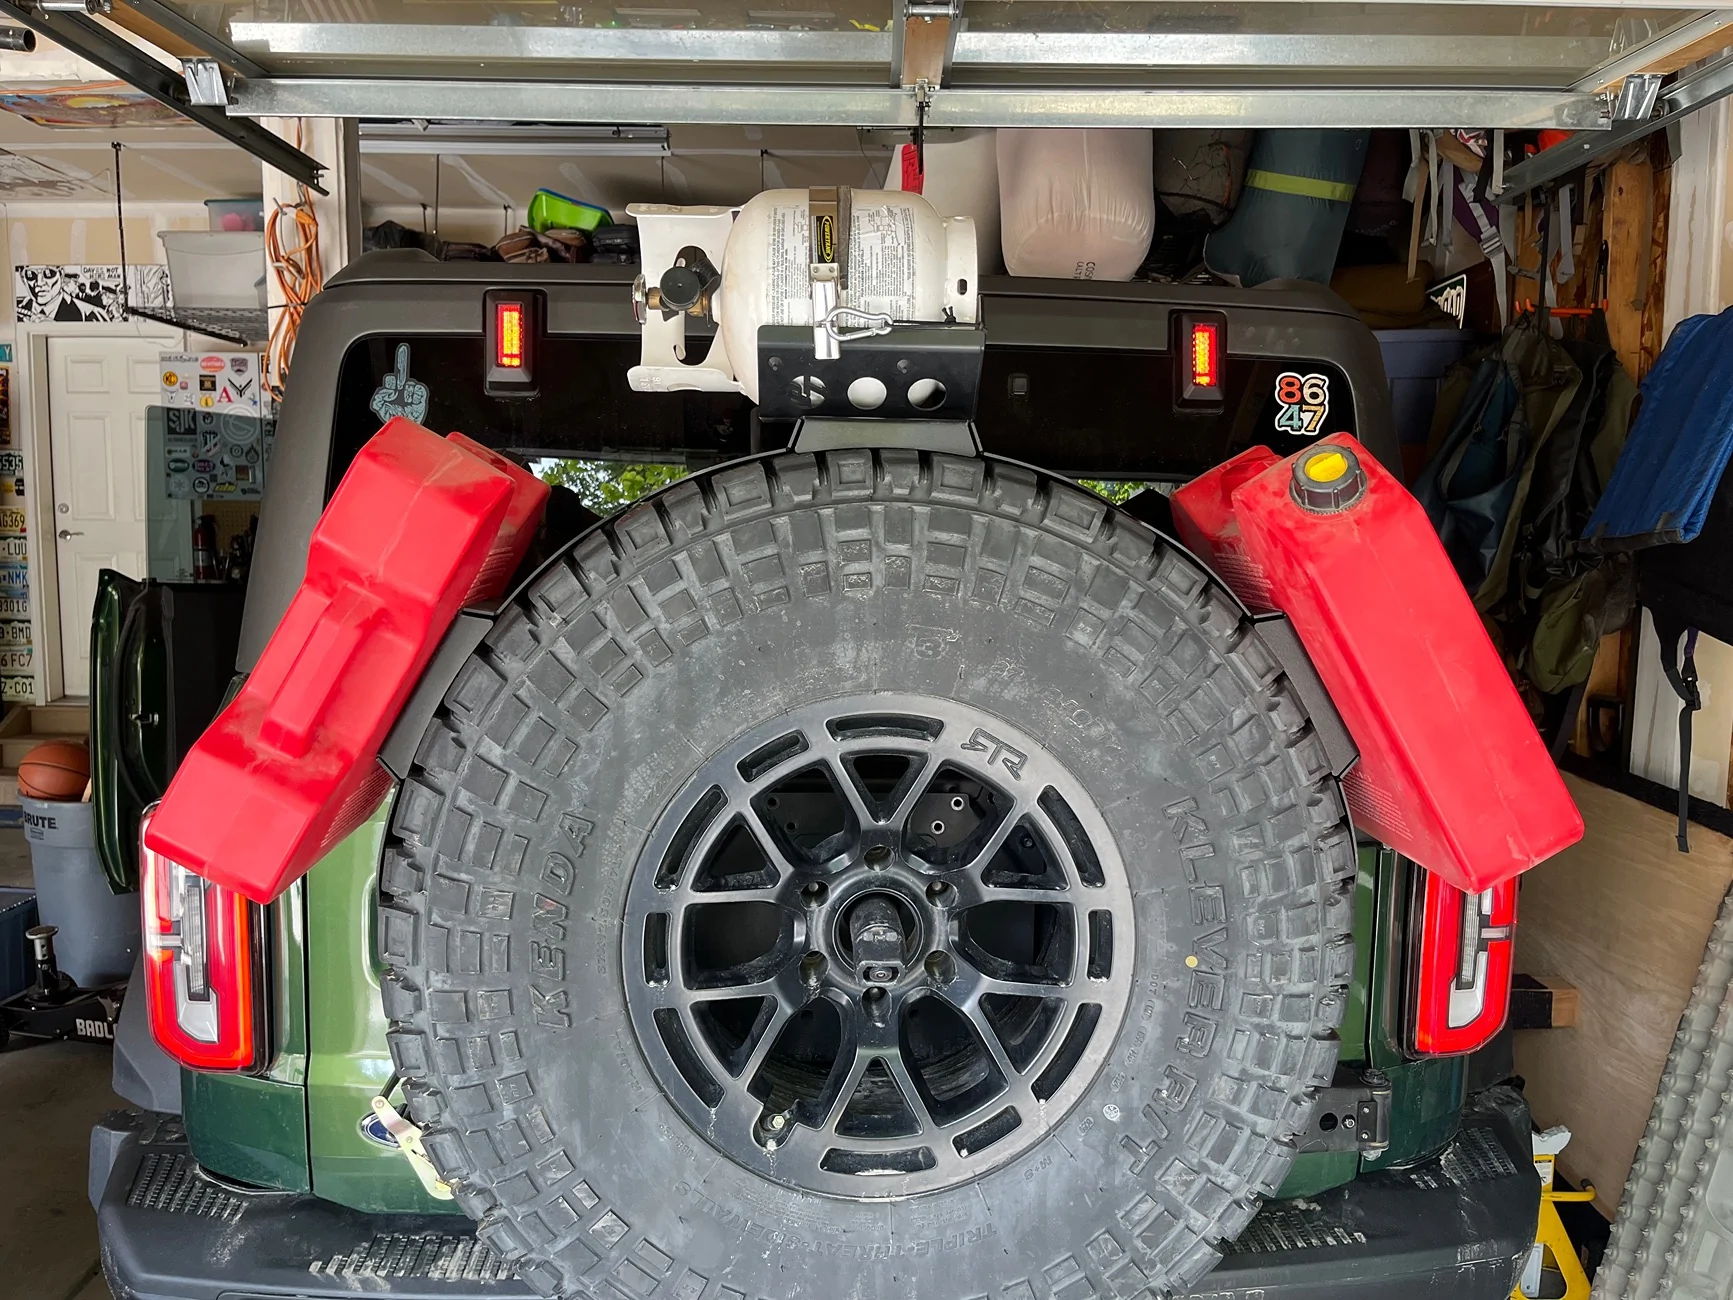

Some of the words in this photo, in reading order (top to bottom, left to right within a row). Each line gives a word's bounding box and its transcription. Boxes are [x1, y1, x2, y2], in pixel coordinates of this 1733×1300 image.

[1278, 375, 1326, 404] 86
[1278, 404, 1326, 431] 47
[24, 810, 57, 830] BRUTE
[529, 812, 595, 1029] KENDA
[1162, 796, 1228, 1058] KLEVER
